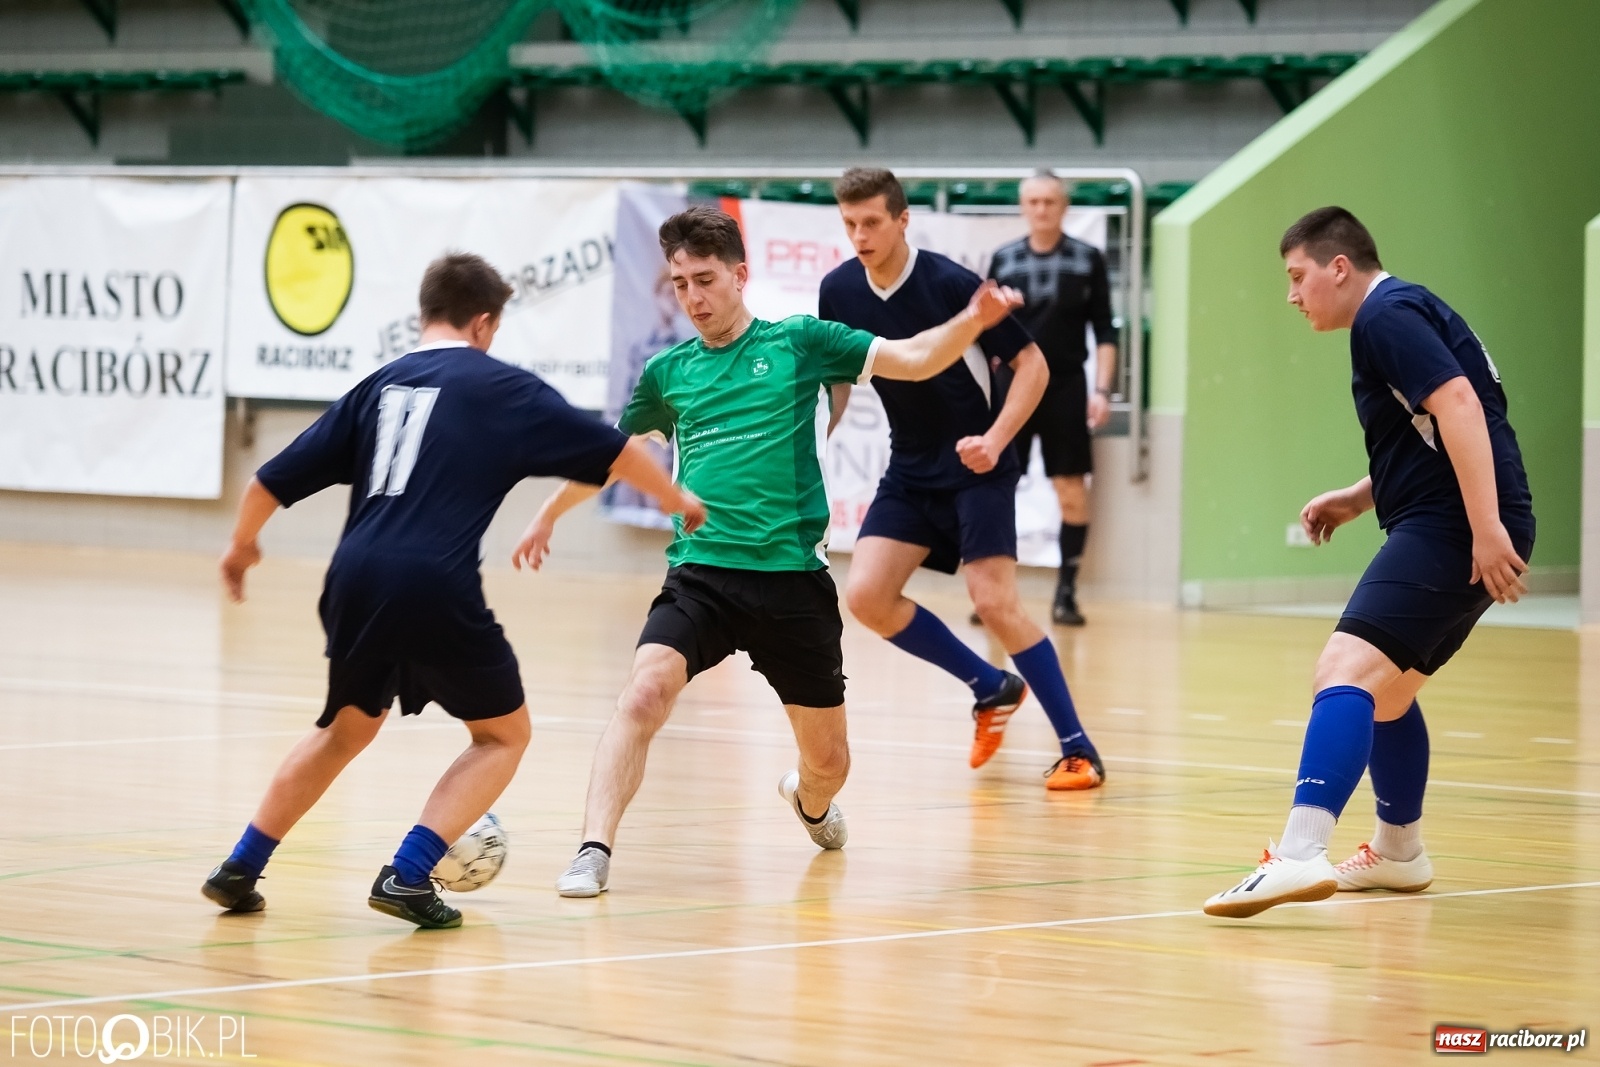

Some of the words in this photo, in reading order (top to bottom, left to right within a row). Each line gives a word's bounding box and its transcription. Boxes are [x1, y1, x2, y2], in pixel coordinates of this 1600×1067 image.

[20, 268, 184, 322] MIASTO
[0, 332, 212, 399] RACIBÓRZ
[374, 313, 421, 362] JES
[366, 384, 441, 498] 11
